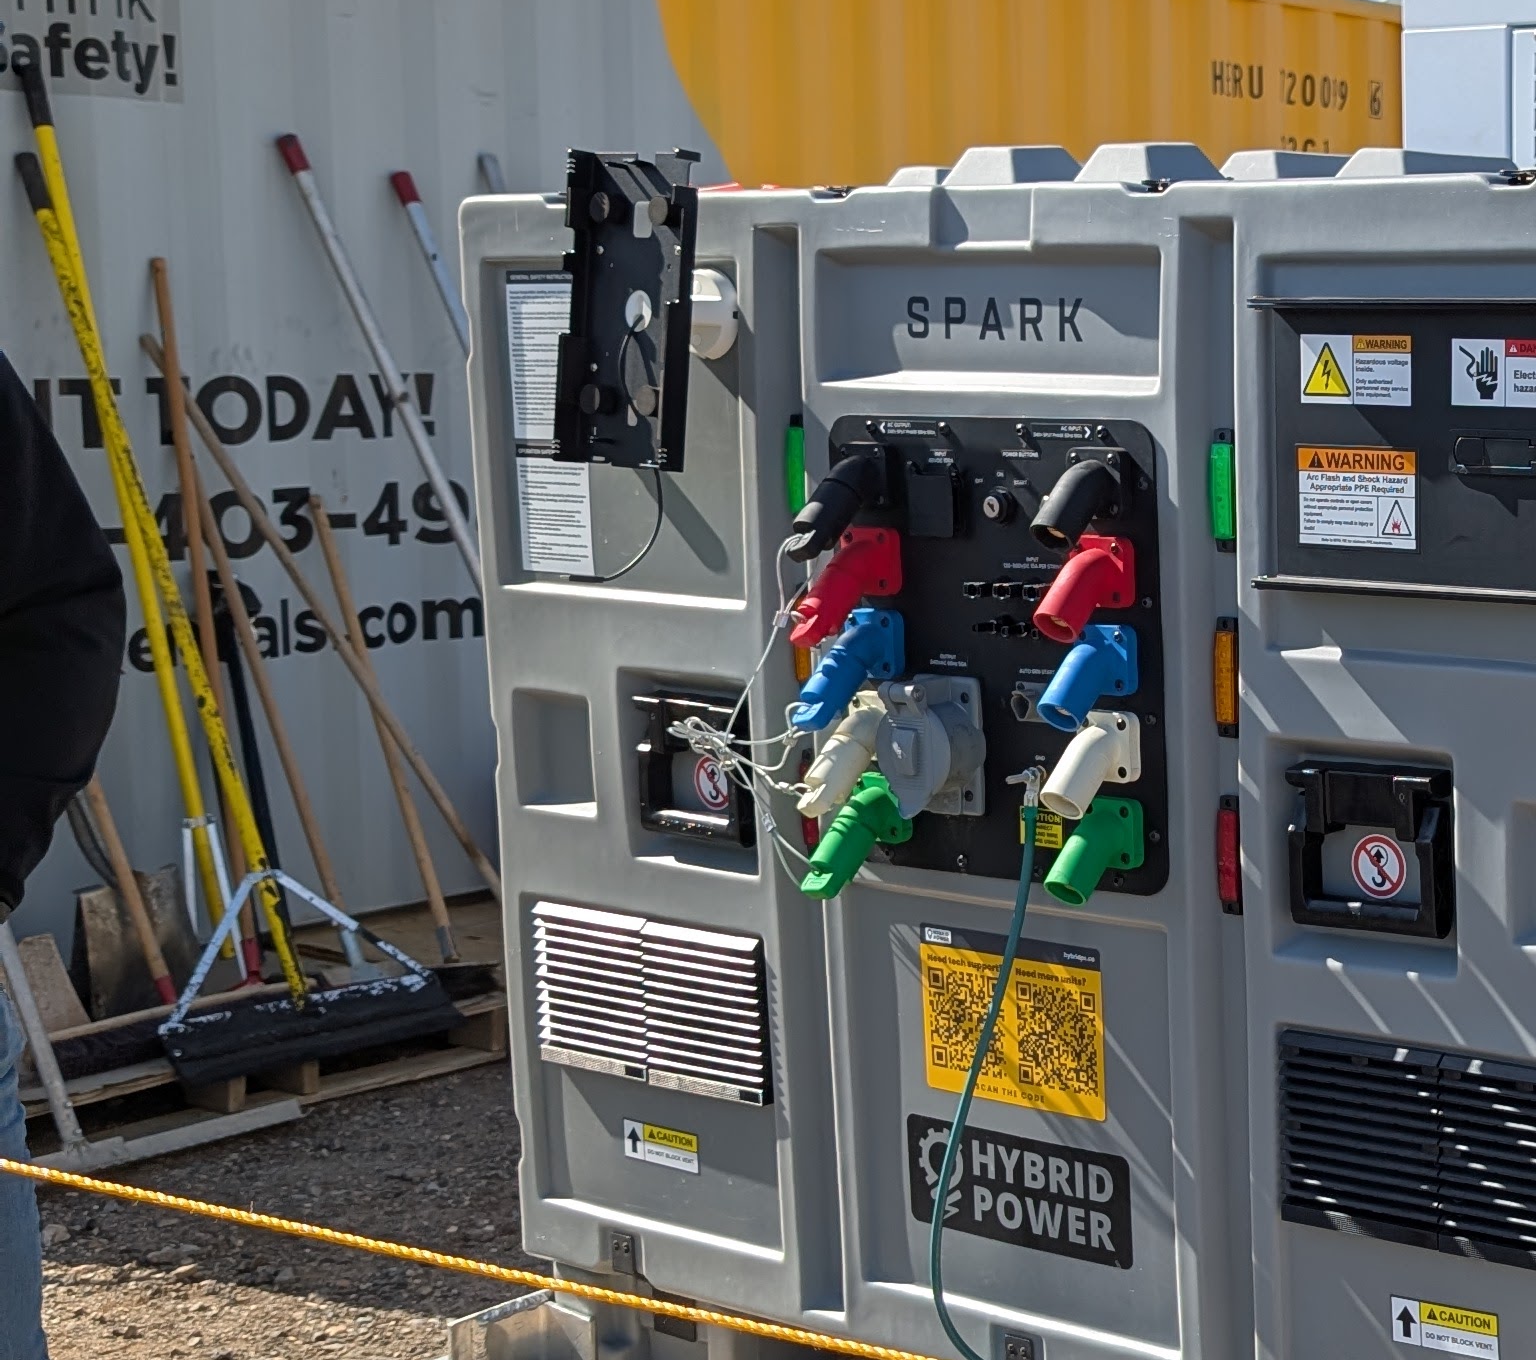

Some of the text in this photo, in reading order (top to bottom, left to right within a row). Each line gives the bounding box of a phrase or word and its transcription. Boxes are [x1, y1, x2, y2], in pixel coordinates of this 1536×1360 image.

[0, 21, 177, 94] afety!
[907, 295, 1084, 342] SPARK
[1364, 339, 1408, 350] WARNING
[146, 372, 436, 448] TODAY!
[1325, 451, 1405, 471] WARNING
[1306, 472, 1408, 485] Arc Flash and Shock Hazard
[1309, 482, 1405, 494] Appropriate PPE Required
[926, 953, 947, 964] Need
[947, 956, 966, 967] tech
[1015, 967, 1087, 987] Need more units?
[975, 1082, 1045, 1104] SCAN THE CODE
[656, 1130, 693, 1148] CAUTION
[971, 1138, 1114, 1204] HYBRID
[972, 1183, 1116, 1253] POWER
[1438, 1310, 1491, 1330] CAUTION
[1425, 1331, 1436, 1340] DO
[1436, 1333, 1450, 1343] NOT
[1451, 1336, 1474, 1348] BLOCK
